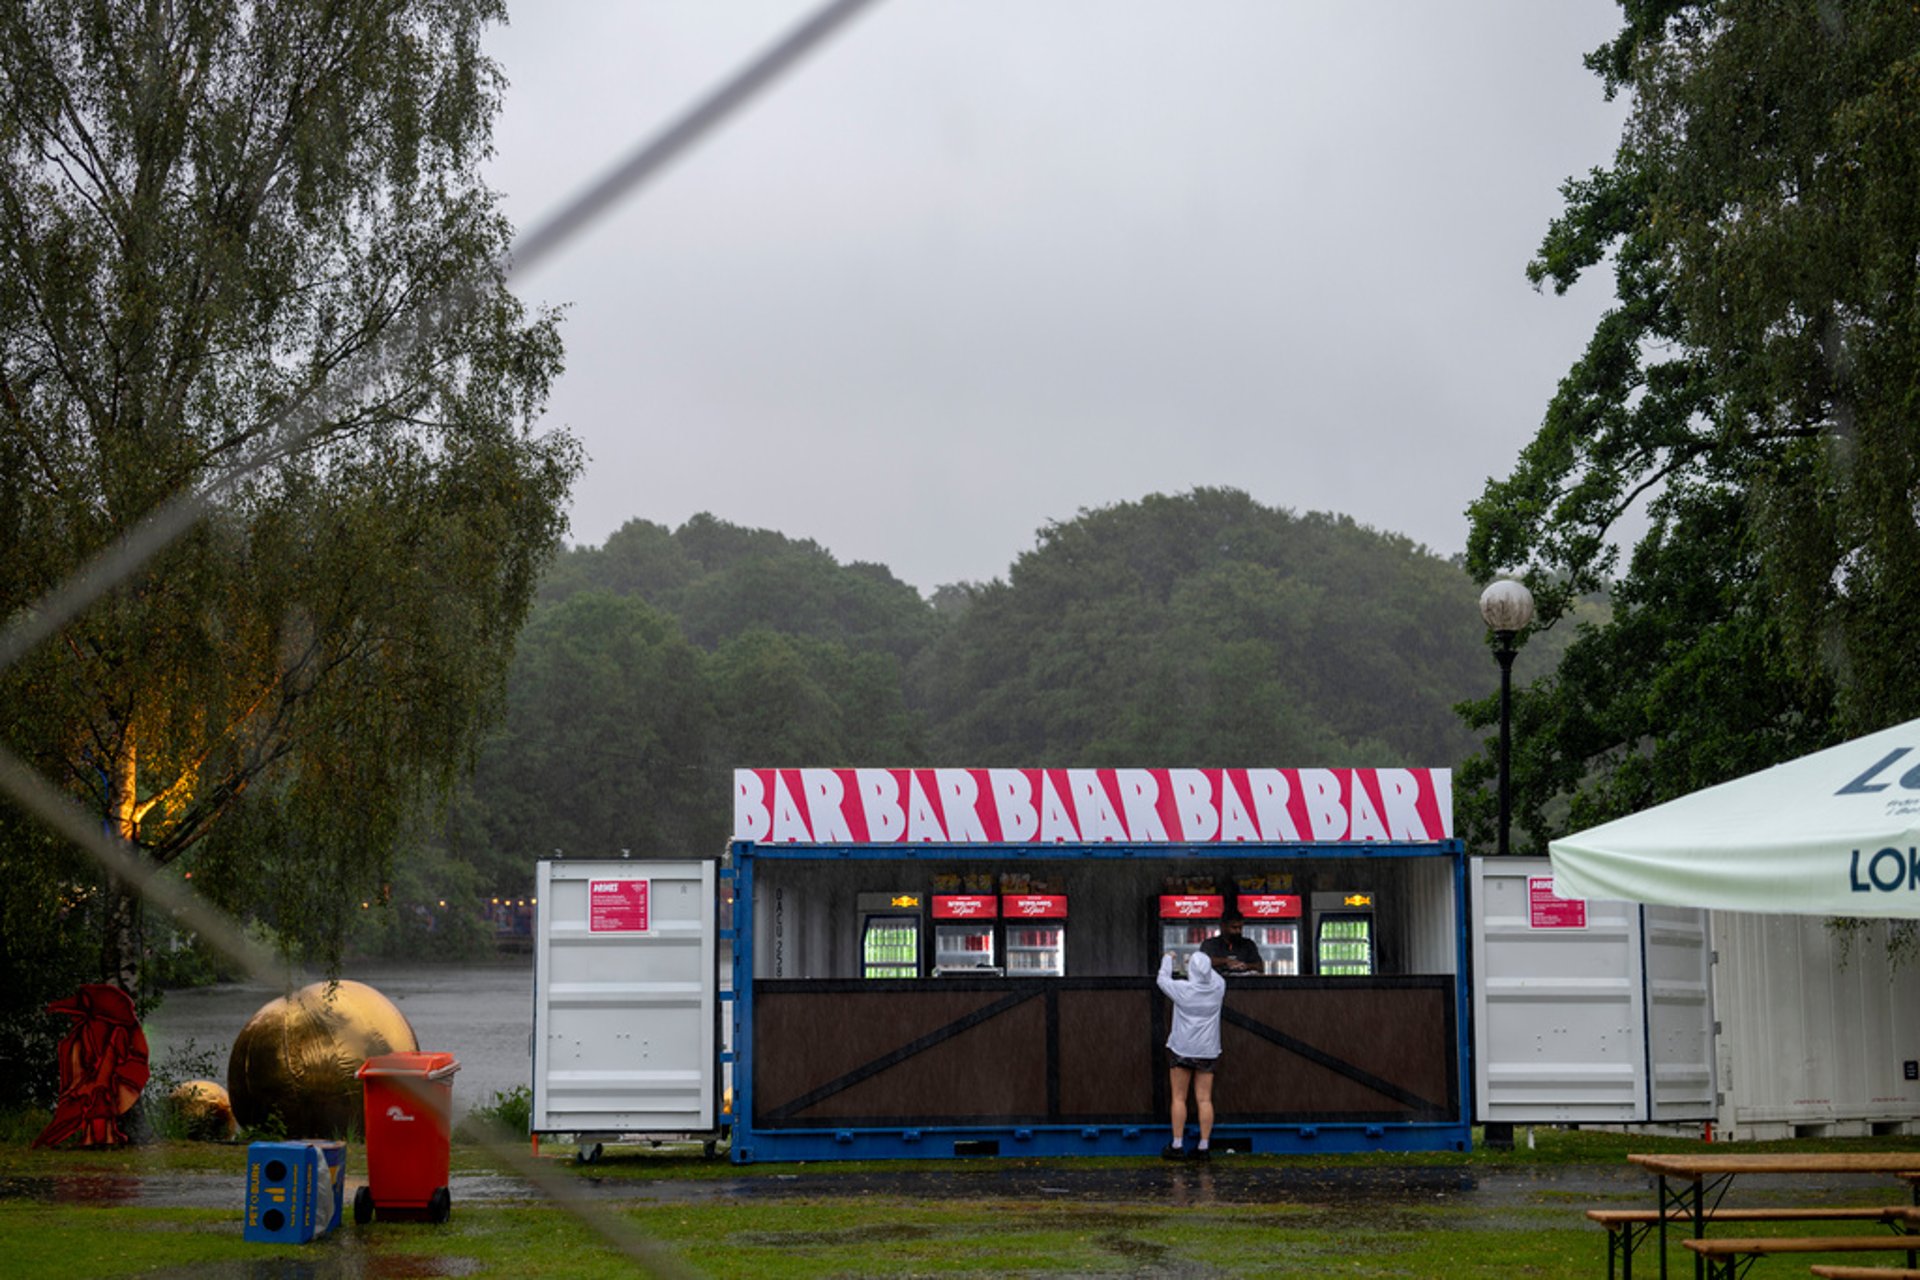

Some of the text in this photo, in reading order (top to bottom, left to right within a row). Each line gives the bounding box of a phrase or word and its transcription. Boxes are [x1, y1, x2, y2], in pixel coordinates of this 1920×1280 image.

[855, 768, 989, 842] BAR
[1168, 768, 1301, 842] BAR
[1298, 768, 1431, 841] BAR
